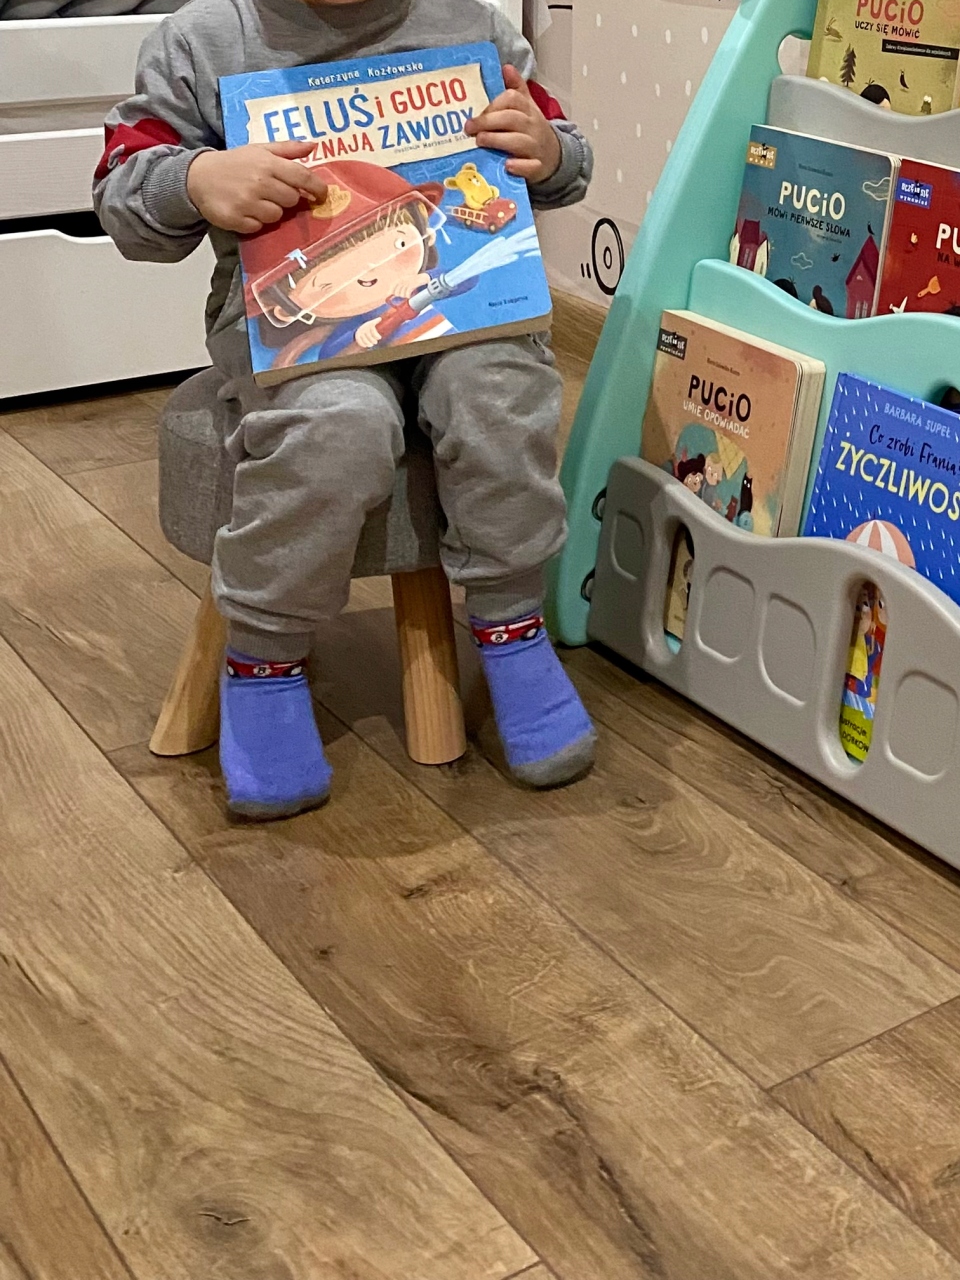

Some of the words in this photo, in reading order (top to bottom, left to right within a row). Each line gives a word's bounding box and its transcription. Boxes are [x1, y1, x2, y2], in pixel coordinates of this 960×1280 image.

[855, 20, 874, 31] UCZY
[307, 71, 360, 87] Katarzyna
[367, 62, 424, 77] Kozłowska
[263, 87, 375, 143] FELUŚ
[374, 96, 385, 118] i
[390, 78, 468, 114] GUCIO
[300, 131, 375, 164] ZNAJĄ
[377, 106, 474, 150] ZAWODY
[779, 181, 846, 220] PUCiO
[825, 222, 851, 237] SŁOWA
[937, 252, 949, 263] NA
[687, 374, 751, 422] PUCiO
[884, 403, 922, 427] BARBARA
[925, 419, 951, 438] SUPEŁ
[869, 424, 884, 445] Co
[887, 437, 914, 457] zrobi
